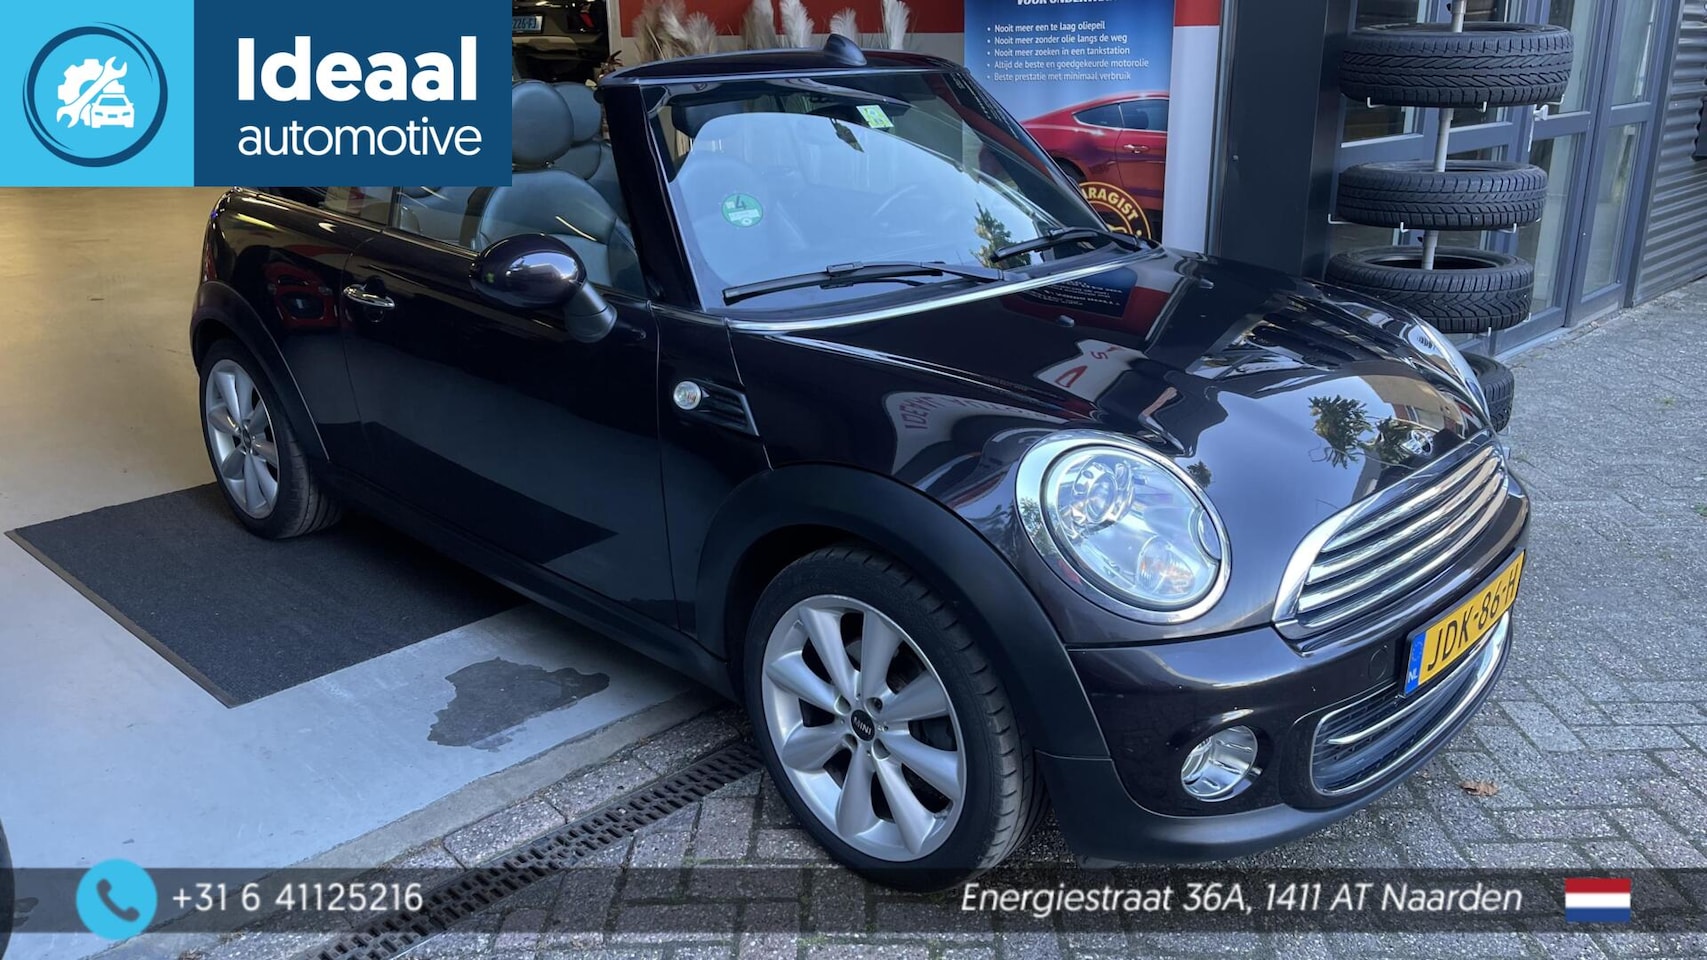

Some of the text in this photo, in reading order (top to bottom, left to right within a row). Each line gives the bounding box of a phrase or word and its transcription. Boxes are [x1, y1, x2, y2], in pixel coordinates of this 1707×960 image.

[995, 24, 1013, 32] Nooit
[1060, 22, 1076, 32] laag
[1078, 20, 1105, 31] oliepeil
[995, 36, 1013, 44] Nooit
[1035, 35, 1059, 44] zonder
[1061, 34, 1075, 43] olie
[1078, 34, 1097, 44] langs
[1099, 34, 1109, 42] de
[1110, 34, 1128, 44] weg
[995, 48, 1013, 56] Nooit
[1034, 48, 1060, 56] zoeken
[1062, 47, 1068, 55] in
[1086, 46, 1130, 54] tankstation
[994, 60, 1012, 70] Altijd
[1024, 60, 1044, 68] beste
[1056, 59, 1108, 70] goedgekeurde
[1110, 58, 1149, 68] motorolie
[994, 72, 1014, 80] Beste
[1015, 72, 1046, 82] prestatie
[1064, 72, 1098, 80] minimaal
[1100, 71, 1131, 80] verbruik
[1428, 563, 1519, 671] JDK-86-H
[852, 716, 872, 736] MINI
